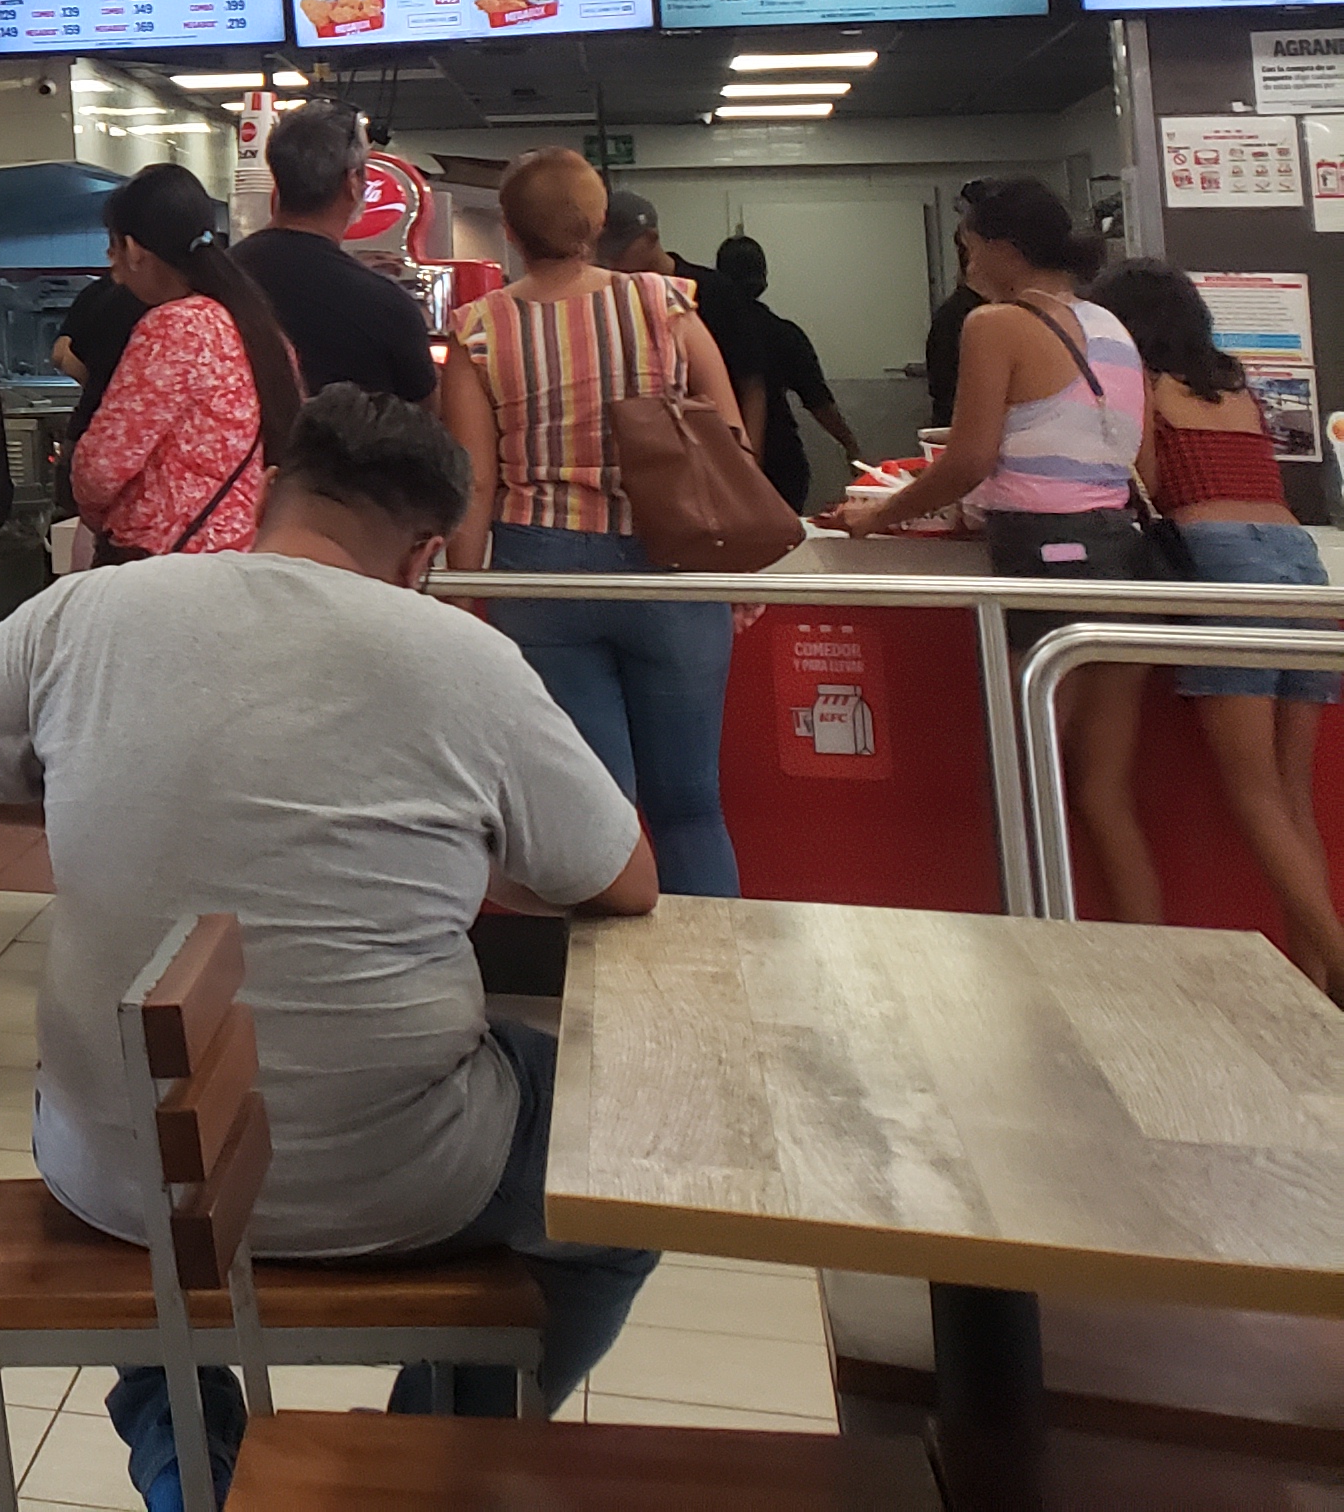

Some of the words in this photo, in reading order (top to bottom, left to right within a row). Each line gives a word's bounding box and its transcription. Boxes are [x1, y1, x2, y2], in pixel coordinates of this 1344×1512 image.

[795, 642, 862, 657] COMEDOR
[802, 659, 829, 672] PARA
[820, 713, 848, 723] KFC
